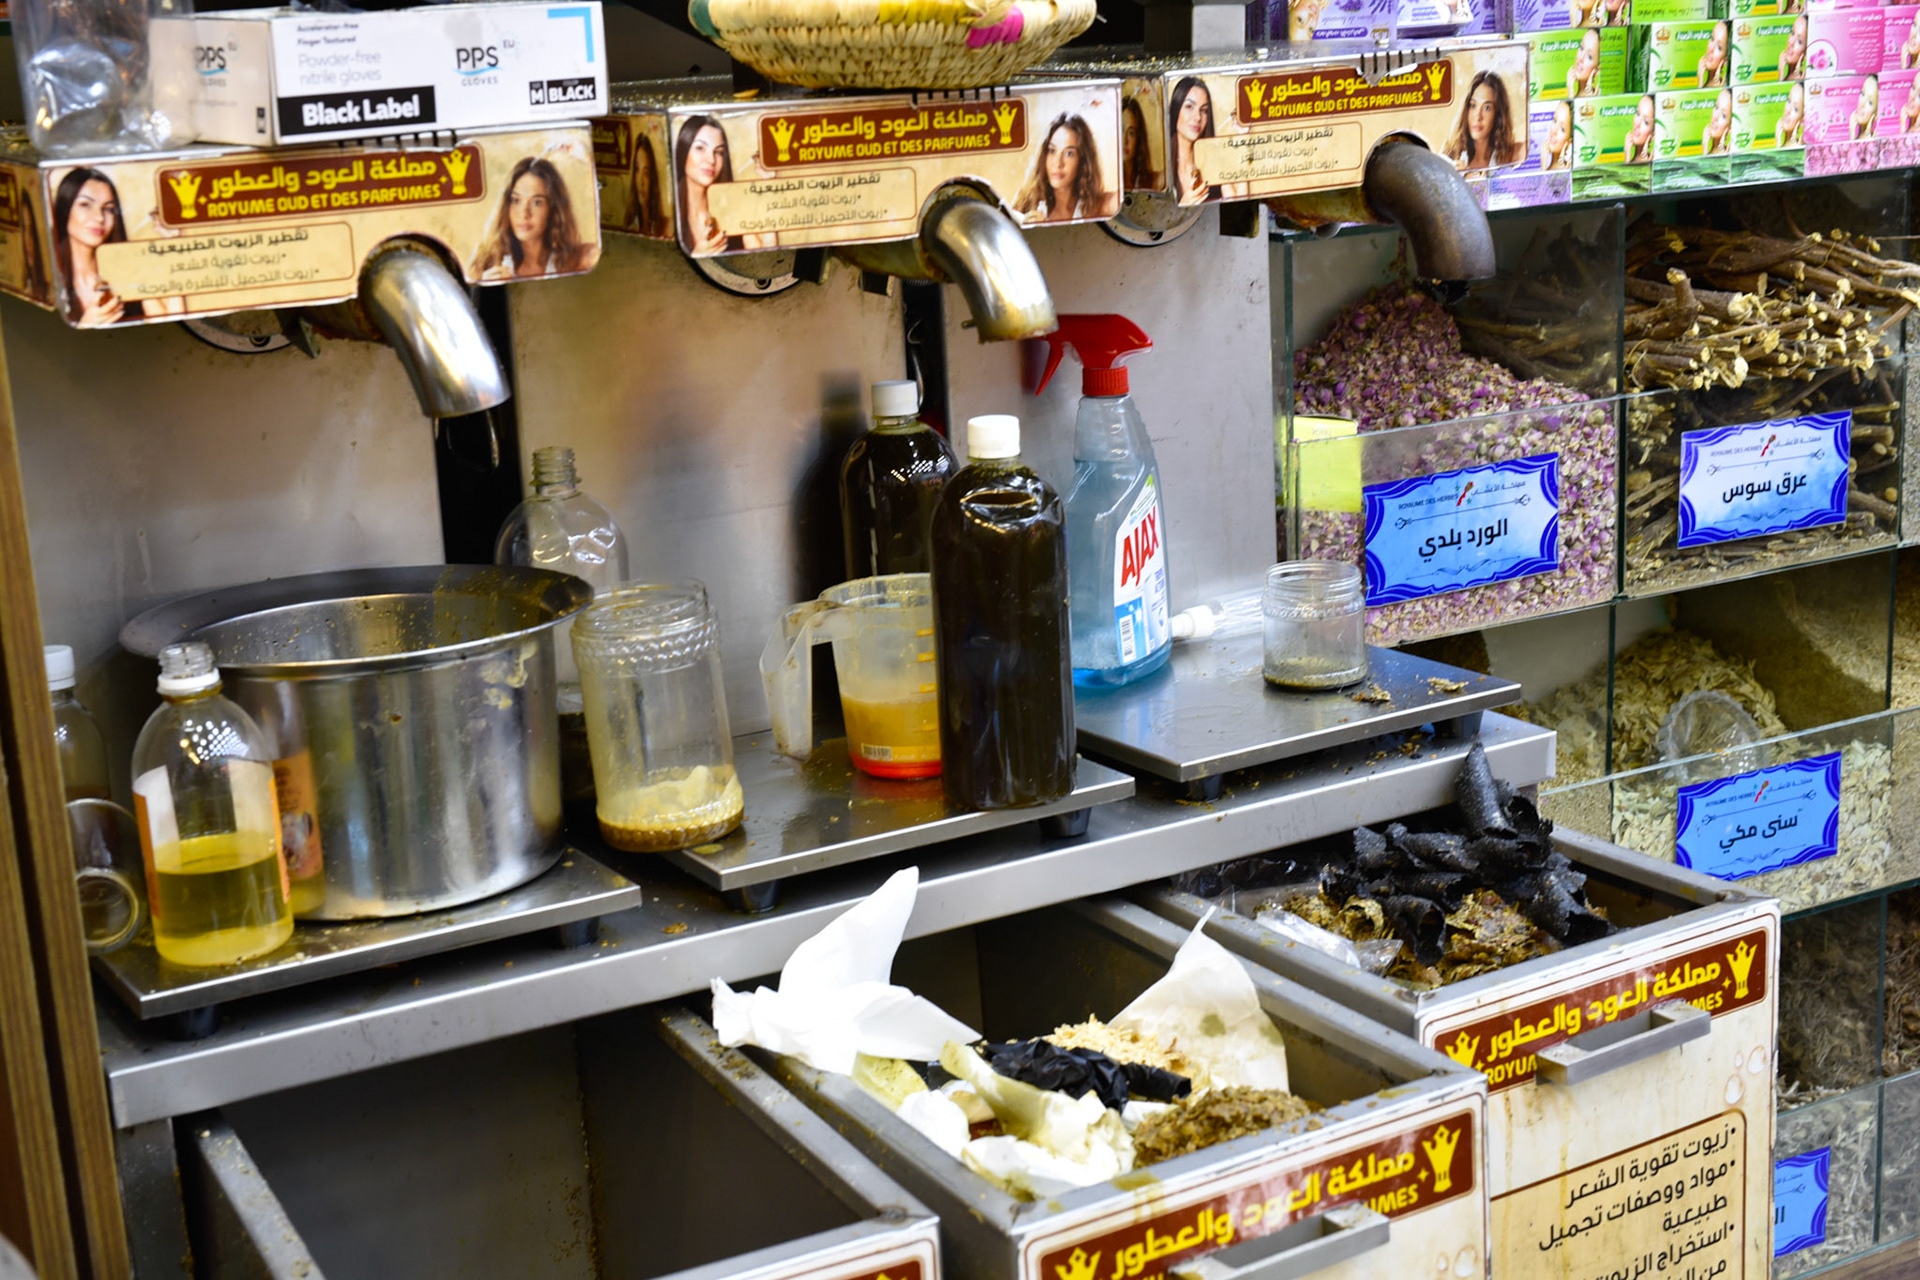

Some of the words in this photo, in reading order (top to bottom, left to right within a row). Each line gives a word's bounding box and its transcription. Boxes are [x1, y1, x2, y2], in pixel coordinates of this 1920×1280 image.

[299, 50, 382, 68] Powder-free
[456, 46, 499, 69] PPS
[300, 71, 337, 85] nitrile
[339, 69, 382, 87] gloves
[461, 76, 499, 87] GLOVES
[1269, 75, 1331, 103] والعطور
[1334, 77, 1373, 95] عود
[531, 88, 544, 104] M
[548, 84, 595, 102] BLACK
[1268, 100, 1313, 119] ROYUME
[1313, 98, 1335, 114] OUD
[1336, 97, 1349, 112] ET
[1349, 95, 1369, 110] DES
[1369, 91, 1424, 108] PARFUMES
[302, 99, 361, 127] Black
[362, 93, 421, 122] Label
[879, 110, 929, 136] العود
[933, 109, 988, 130] مملكة
[801, 115, 876, 145] والعطور
[1272, 130, 1303, 145] الزيوت
[1305, 127, 1334, 143] تقطير
[799, 142, 854, 161] ROYUME
[856, 140, 882, 157] OUD
[883, 139, 899, 155] ET
[899, 137, 923, 153] DES
[923, 133, 991, 151] PARFUMES
[208, 165, 300, 200] والعطور
[304, 160, 364, 189] العود
[369, 158, 437, 180] مملكة
[845, 172, 881, 190] تقطير
[806, 175, 844, 192] الزيوت
[206, 196, 275, 218] ROYUME
[277, 193, 309, 212] OUD
[310, 192, 328, 209] ET
[330, 190, 359, 207] DES
[360, 183, 441, 205] PARFUMES
[218, 233, 263, 249] الزيوت
[267, 228, 309, 246] تقطير
[1722, 479, 1772, 504] سوس
[1776, 472, 1808, 496] عرق
[1121, 504, 1160, 588] AJAX
[1418, 528, 1461, 563] بلدي
[1467, 517, 1508, 547] الورد
[1719, 824, 1758, 854] مكي
[1652, 960, 1721, 998] مملكة
[1586, 977, 1649, 1022] العود
[1486, 1002, 1582, 1062] والعطور
[1683, 1123, 1730, 1159] زيوت
[1327, 1150, 1415, 1196] مملكة
[1629, 1142, 1680, 1182] تقوية
[1689, 1162, 1728, 1190] مواد
[1243, 1173, 1320, 1228] العود
[1564, 1164, 1625, 1210] الشعر
[1606, 1180, 1685, 1222] ووصفات
[1538, 1204, 1602, 1251] تجميل
[1663, 1193, 1728, 1235] طبيعية
[1110, 1208, 1235, 1280] والعطور
[1656, 1221, 1728, 1271] استخراج
